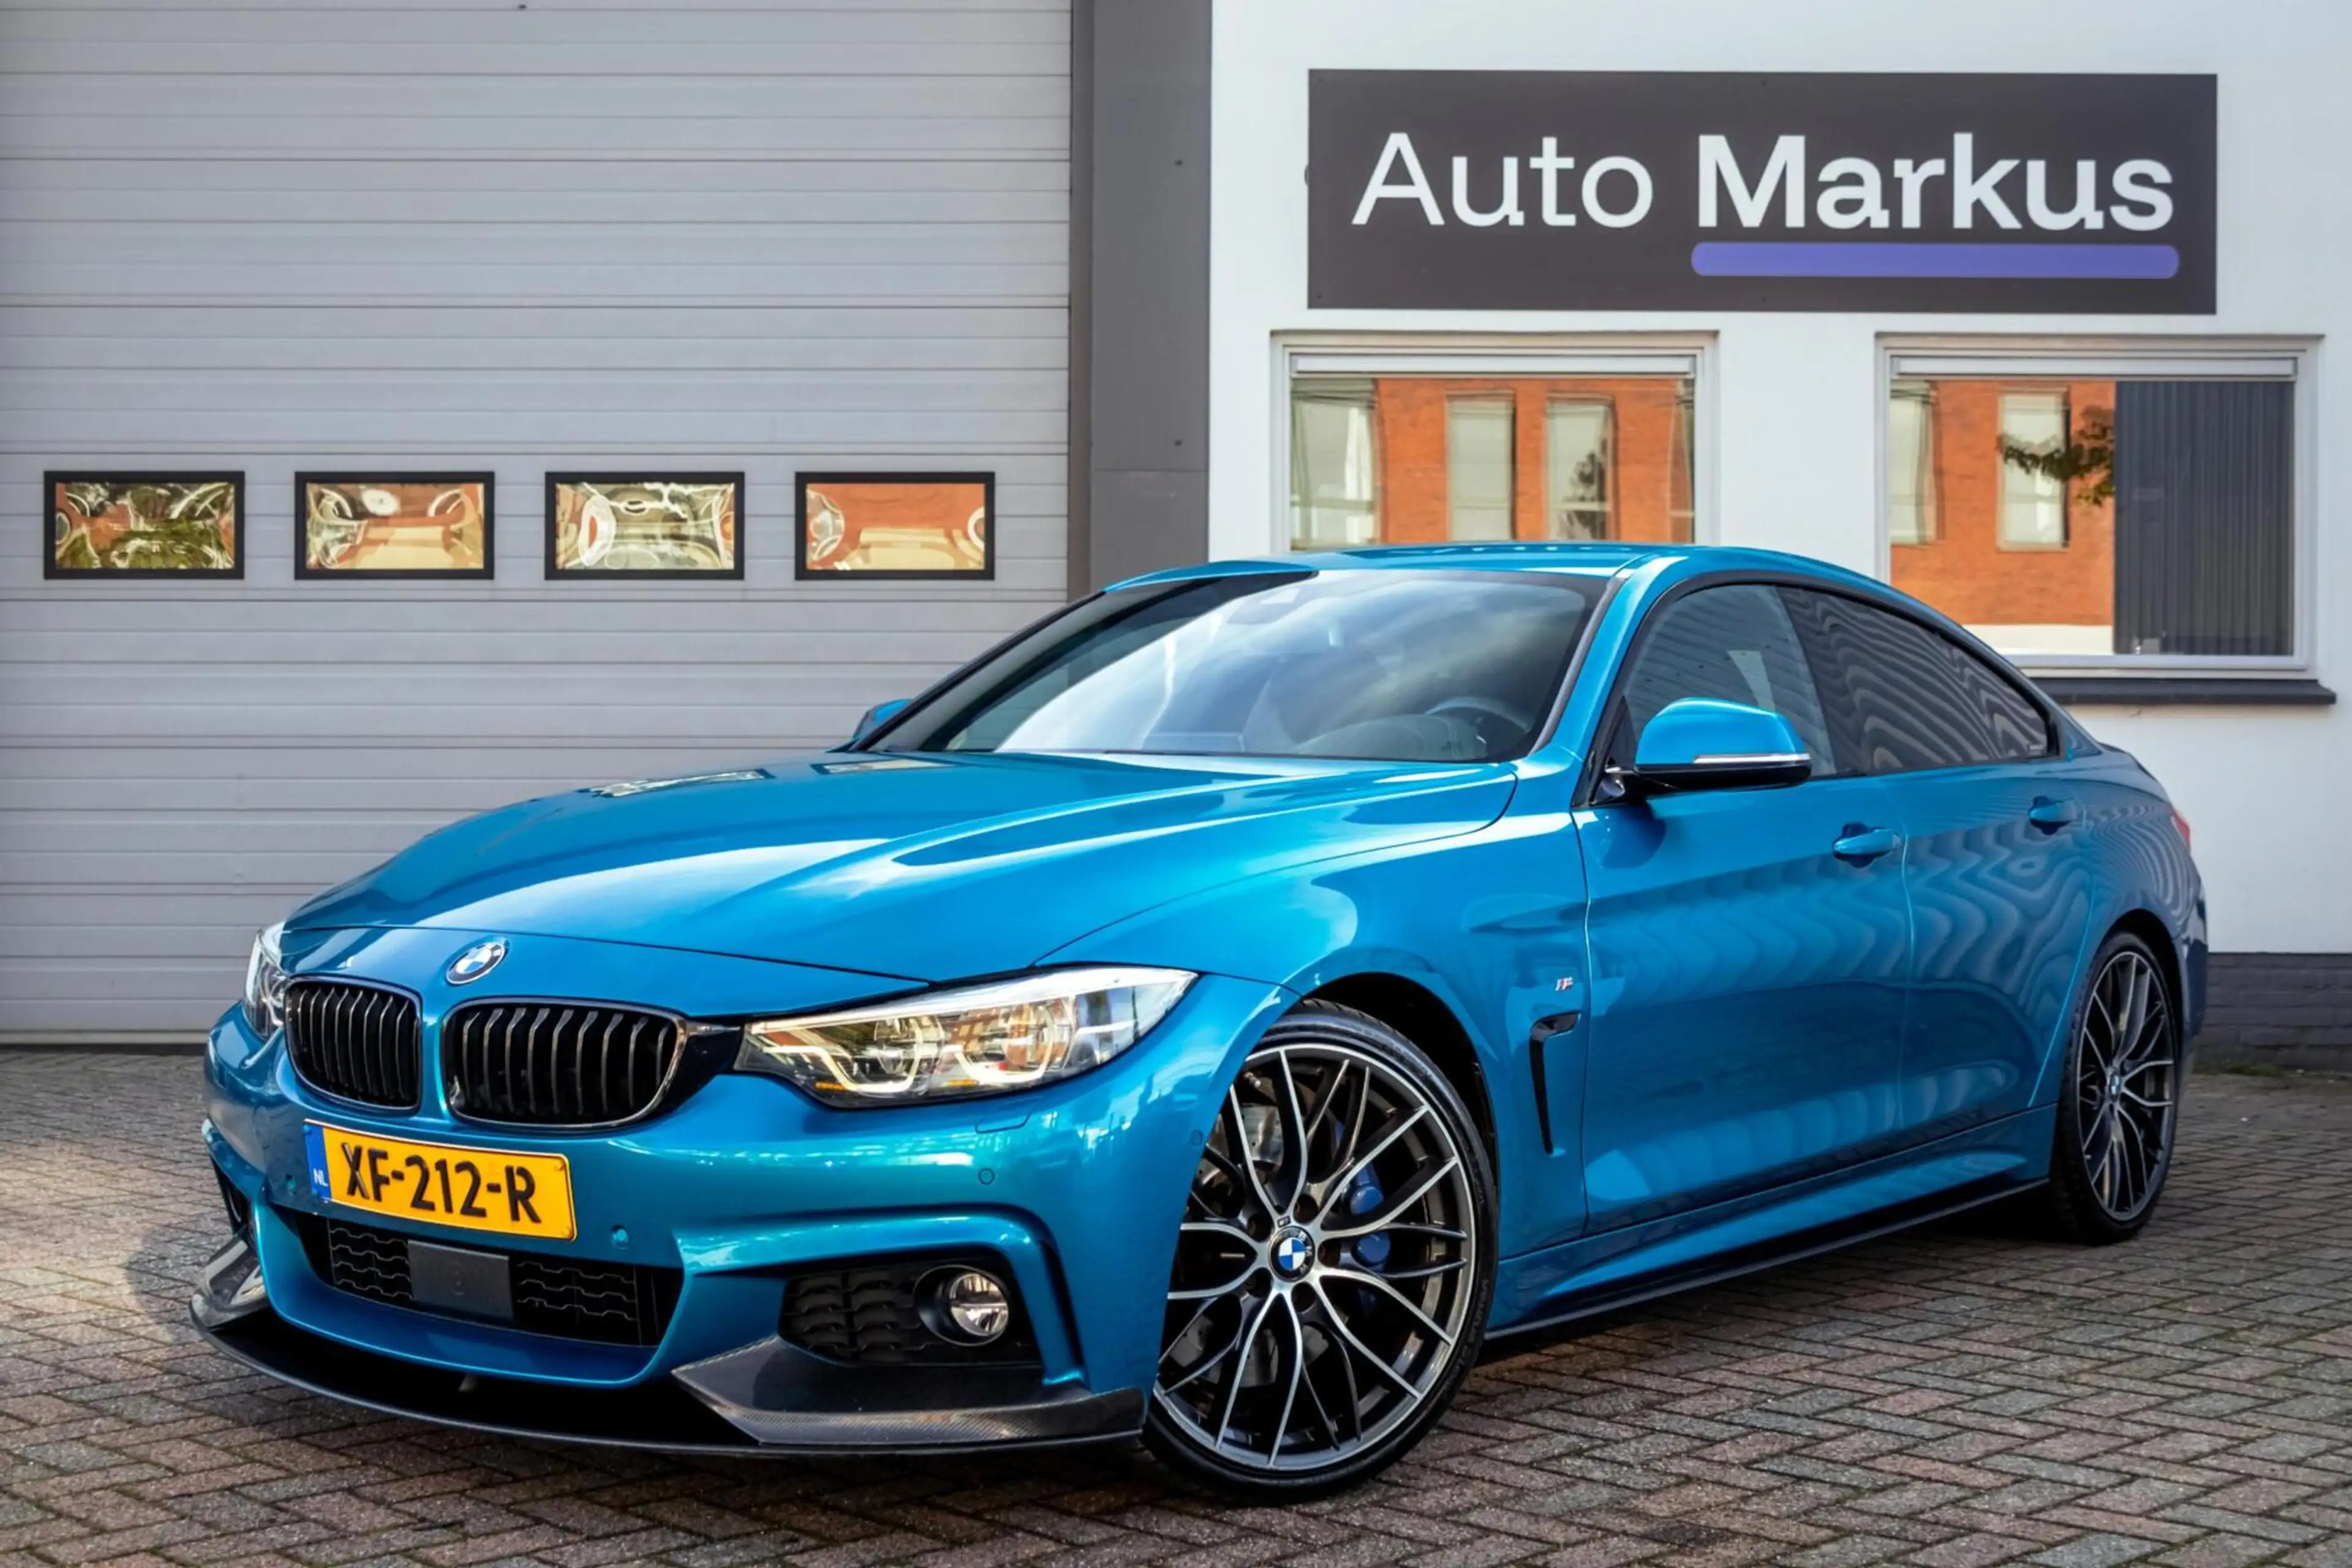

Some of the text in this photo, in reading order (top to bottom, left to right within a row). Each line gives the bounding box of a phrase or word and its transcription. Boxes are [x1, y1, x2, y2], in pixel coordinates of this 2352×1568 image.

[1351, 132, 2173, 231] Auto Markus
[313, 1167, 328, 1187] NL
[341, 1142, 542, 1224] XF-212-R
